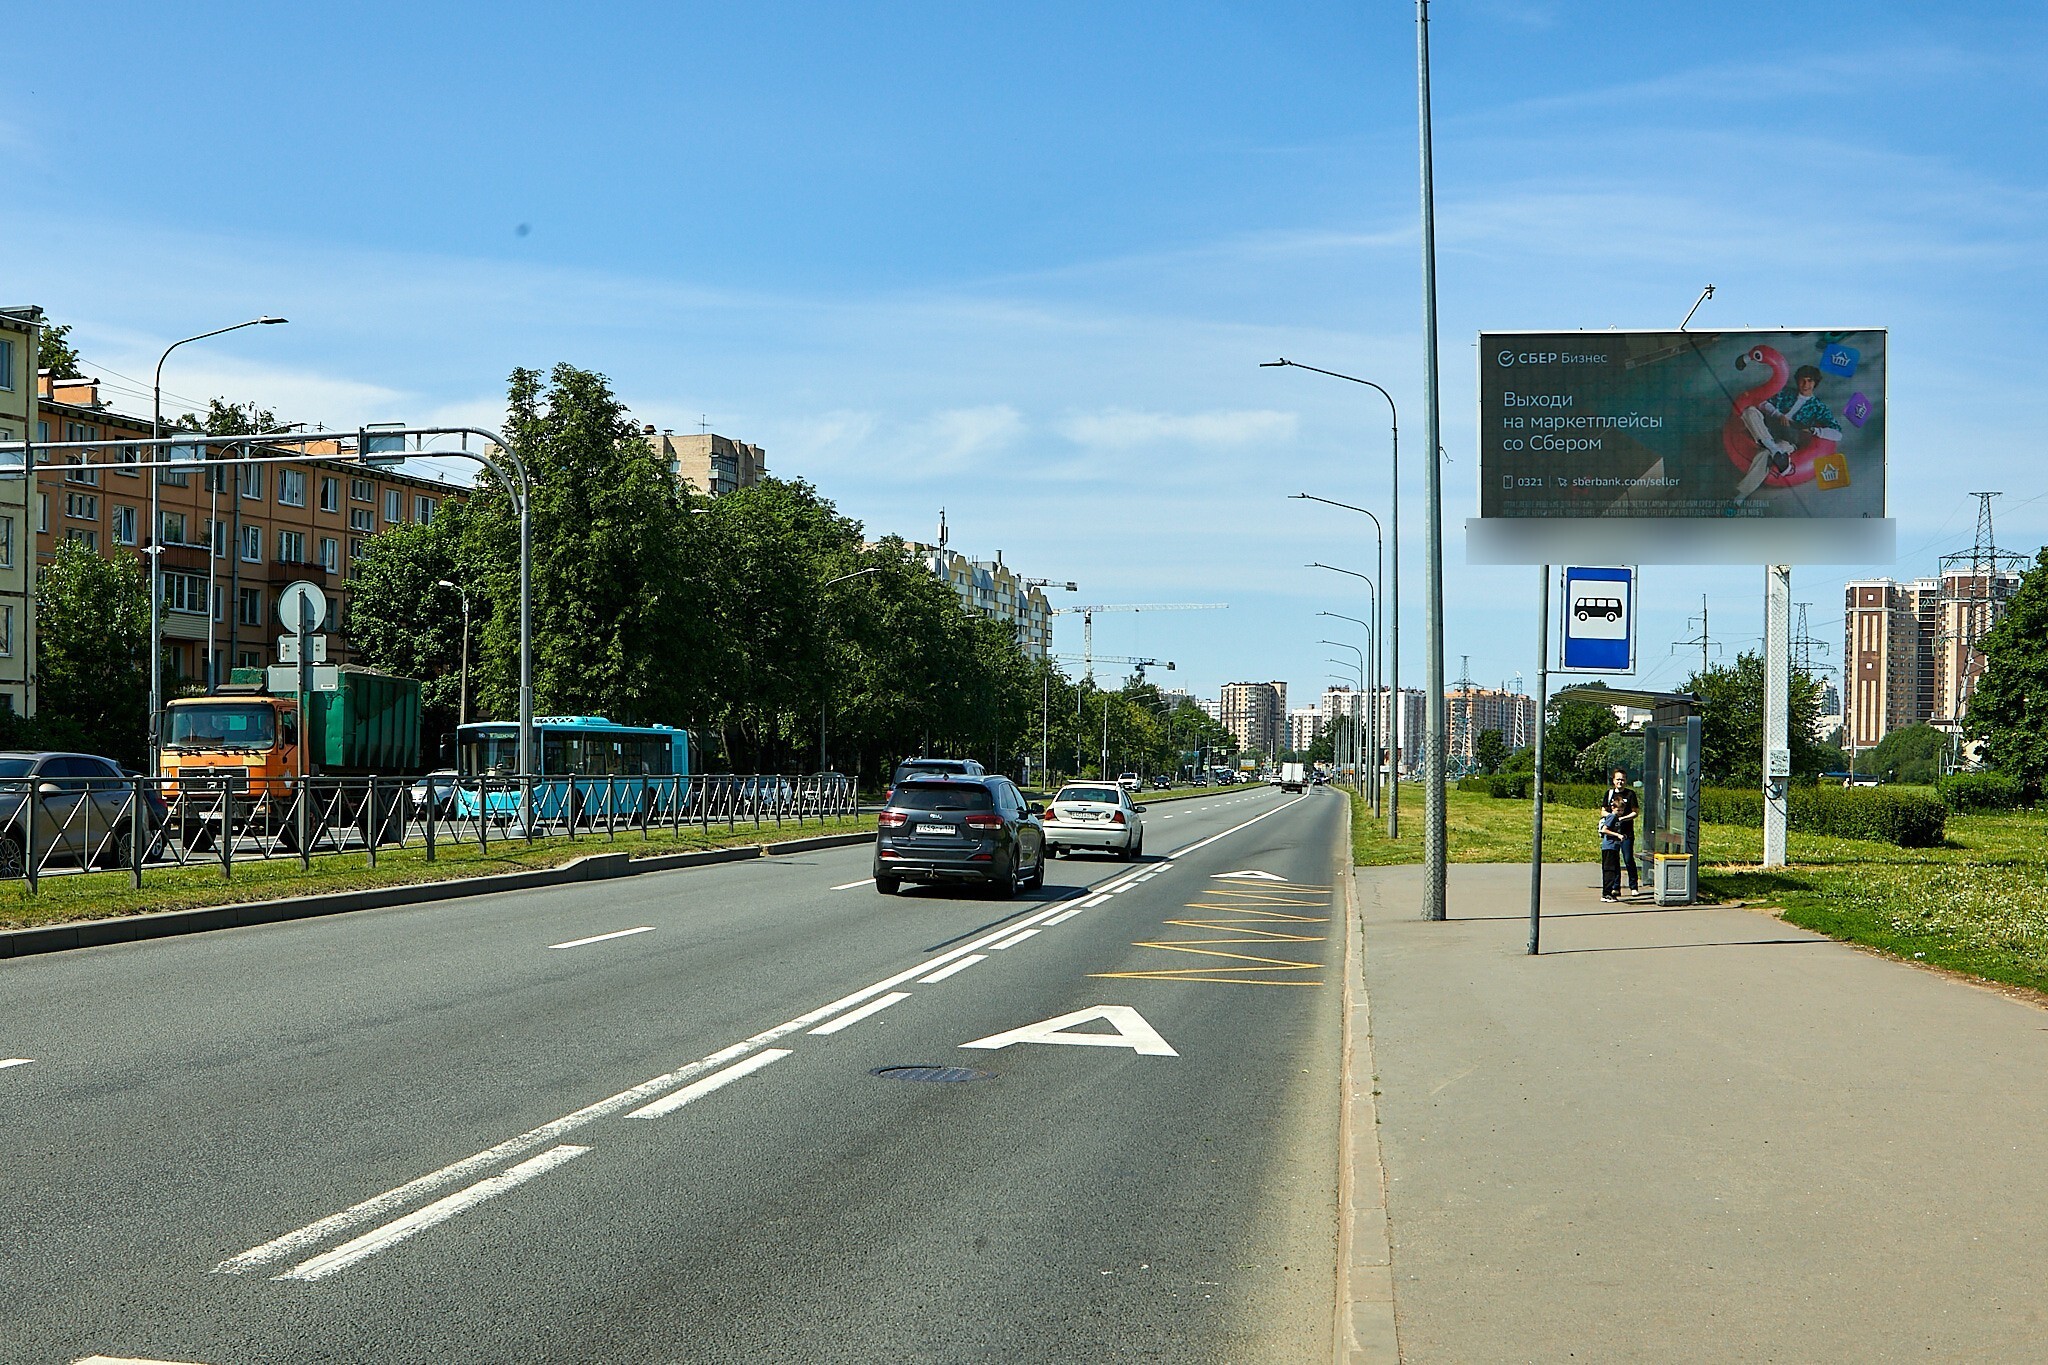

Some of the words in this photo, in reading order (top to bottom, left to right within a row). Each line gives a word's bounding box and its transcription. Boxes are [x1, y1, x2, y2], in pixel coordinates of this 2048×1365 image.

[1518, 353, 1557, 364] СБЕР
[1561, 352, 1608, 363] Бизнес
[1503, 391, 1573, 409] Выходи
[1503, 417, 1524, 429] на
[1531, 412, 1662, 431] маркетплейсы
[1503, 439, 1523, 451] со
[1529, 434, 1602, 454] Сбером
[1517, 477, 1543, 487] 0321
[1572, 476, 1680, 489] sberbank.com/seller
